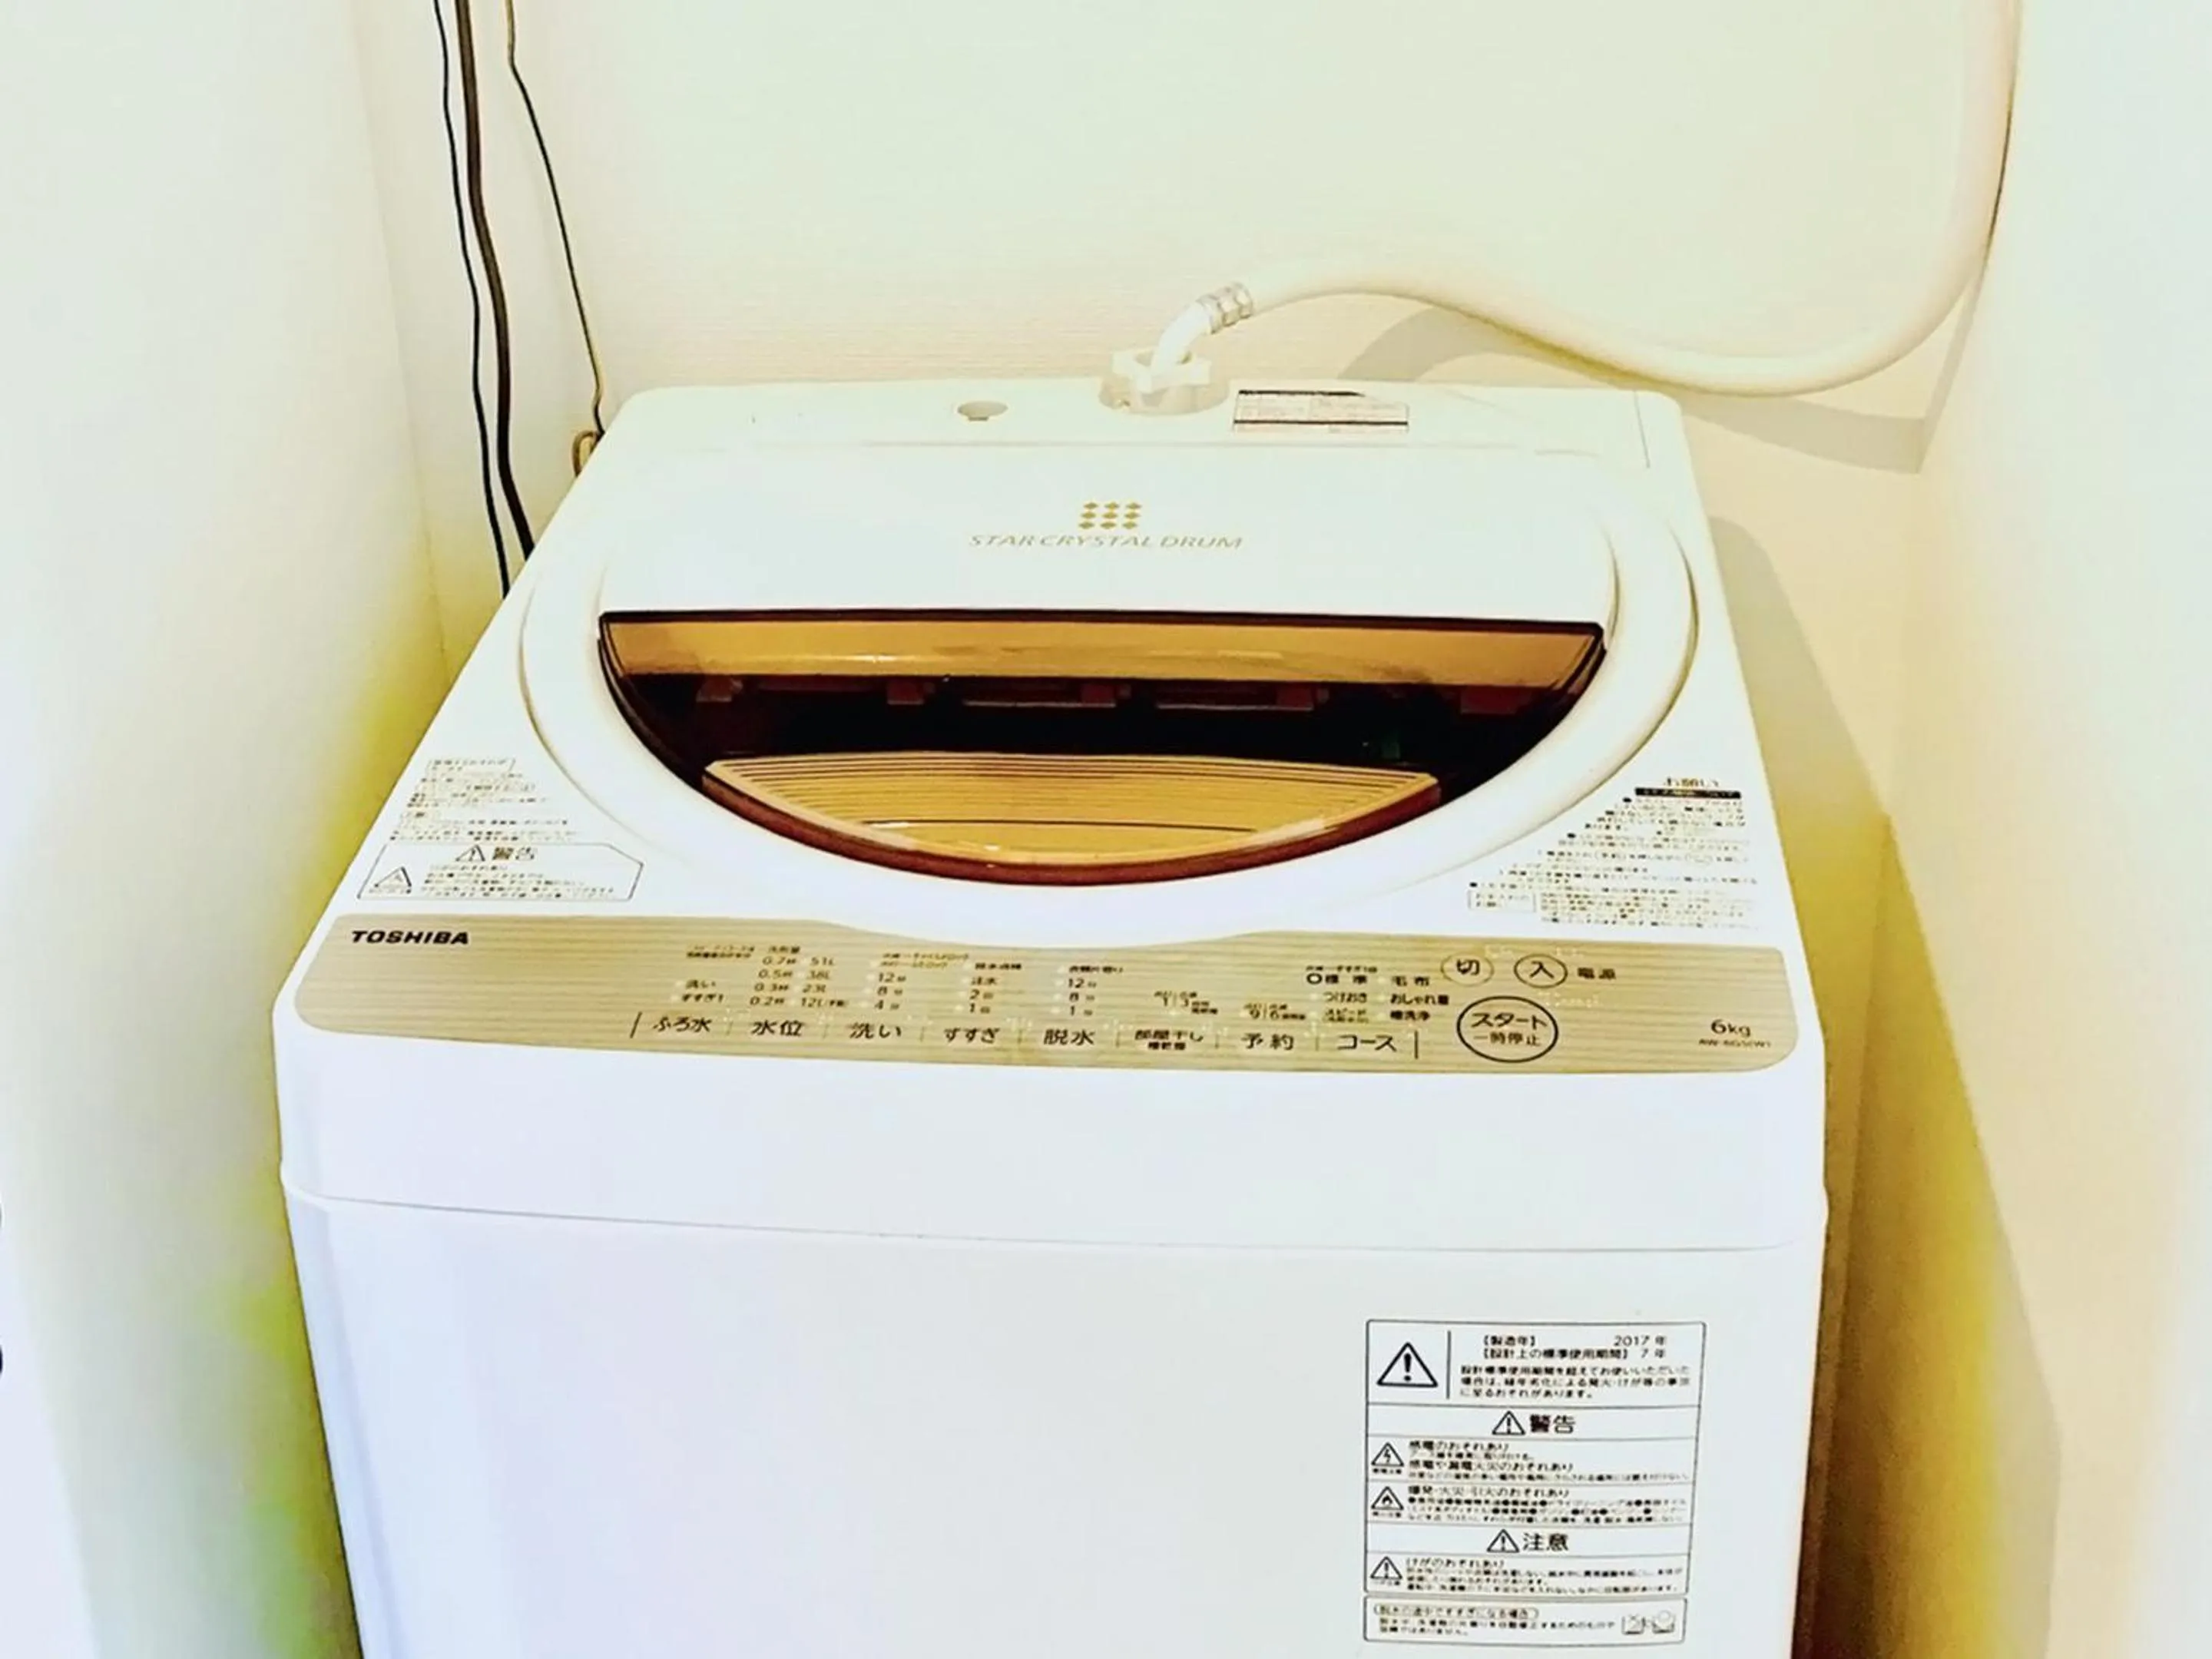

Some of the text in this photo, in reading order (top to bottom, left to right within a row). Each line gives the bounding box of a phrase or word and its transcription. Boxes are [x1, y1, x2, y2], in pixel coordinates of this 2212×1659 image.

[969, 535, 1243, 548] STAR CRYSTAL DRUM
[352, 930, 469, 945] TOSHIBA
[1529, 961, 1555, 979] 入
[1578, 966, 1617, 980] 電源
[652, 1015, 712, 1033] ふろ水
[750, 1019, 804, 1037] 水位
[1471, 1012, 1548, 1030] スタート
[1711, 1018, 1751, 1038] 6kg
[848, 1022, 902, 1039] 洗い
[944, 1027, 1001, 1045] すすぎ
[1043, 1028, 1095, 1045] 脱水
[1473, 1032, 1541, 1046] 一時停止
[1241, 1032, 1295, 1051] 予約
[1337, 1035, 1397, 1052] コース
[1614, 1335, 1650, 1346] 2017
[1529, 1414, 1575, 1433] 警告
[1522, 1533, 1569, 1551] 注意
